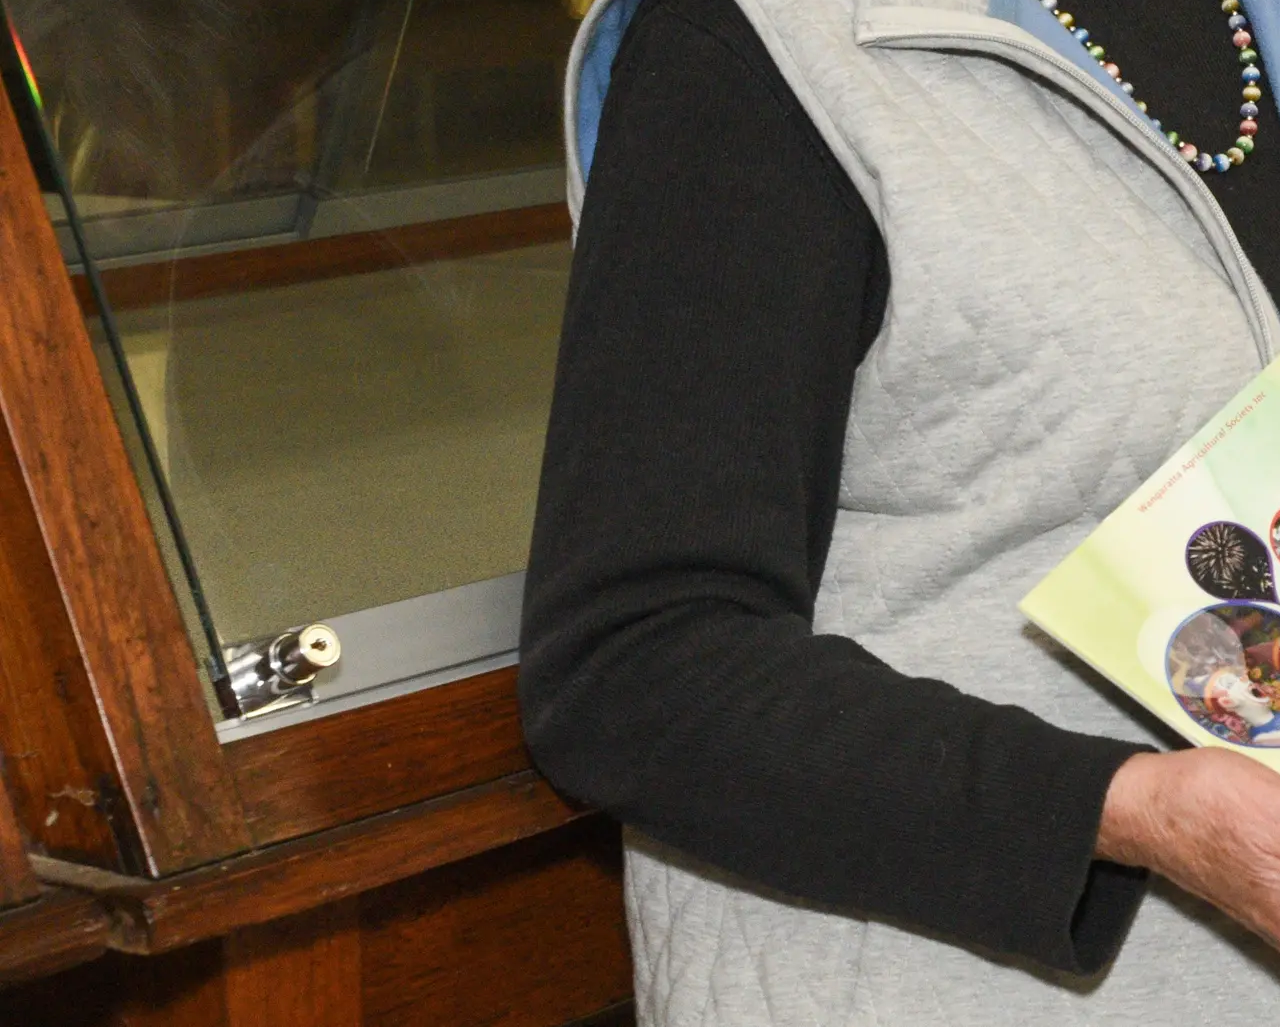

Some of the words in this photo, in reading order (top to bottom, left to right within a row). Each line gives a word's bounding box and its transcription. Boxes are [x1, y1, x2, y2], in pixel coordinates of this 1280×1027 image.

[1138, 472, 1182, 513] Wangaratta
[1182, 427, 1227, 472] Agricultural
[1226, 404, 1254, 430] Society
